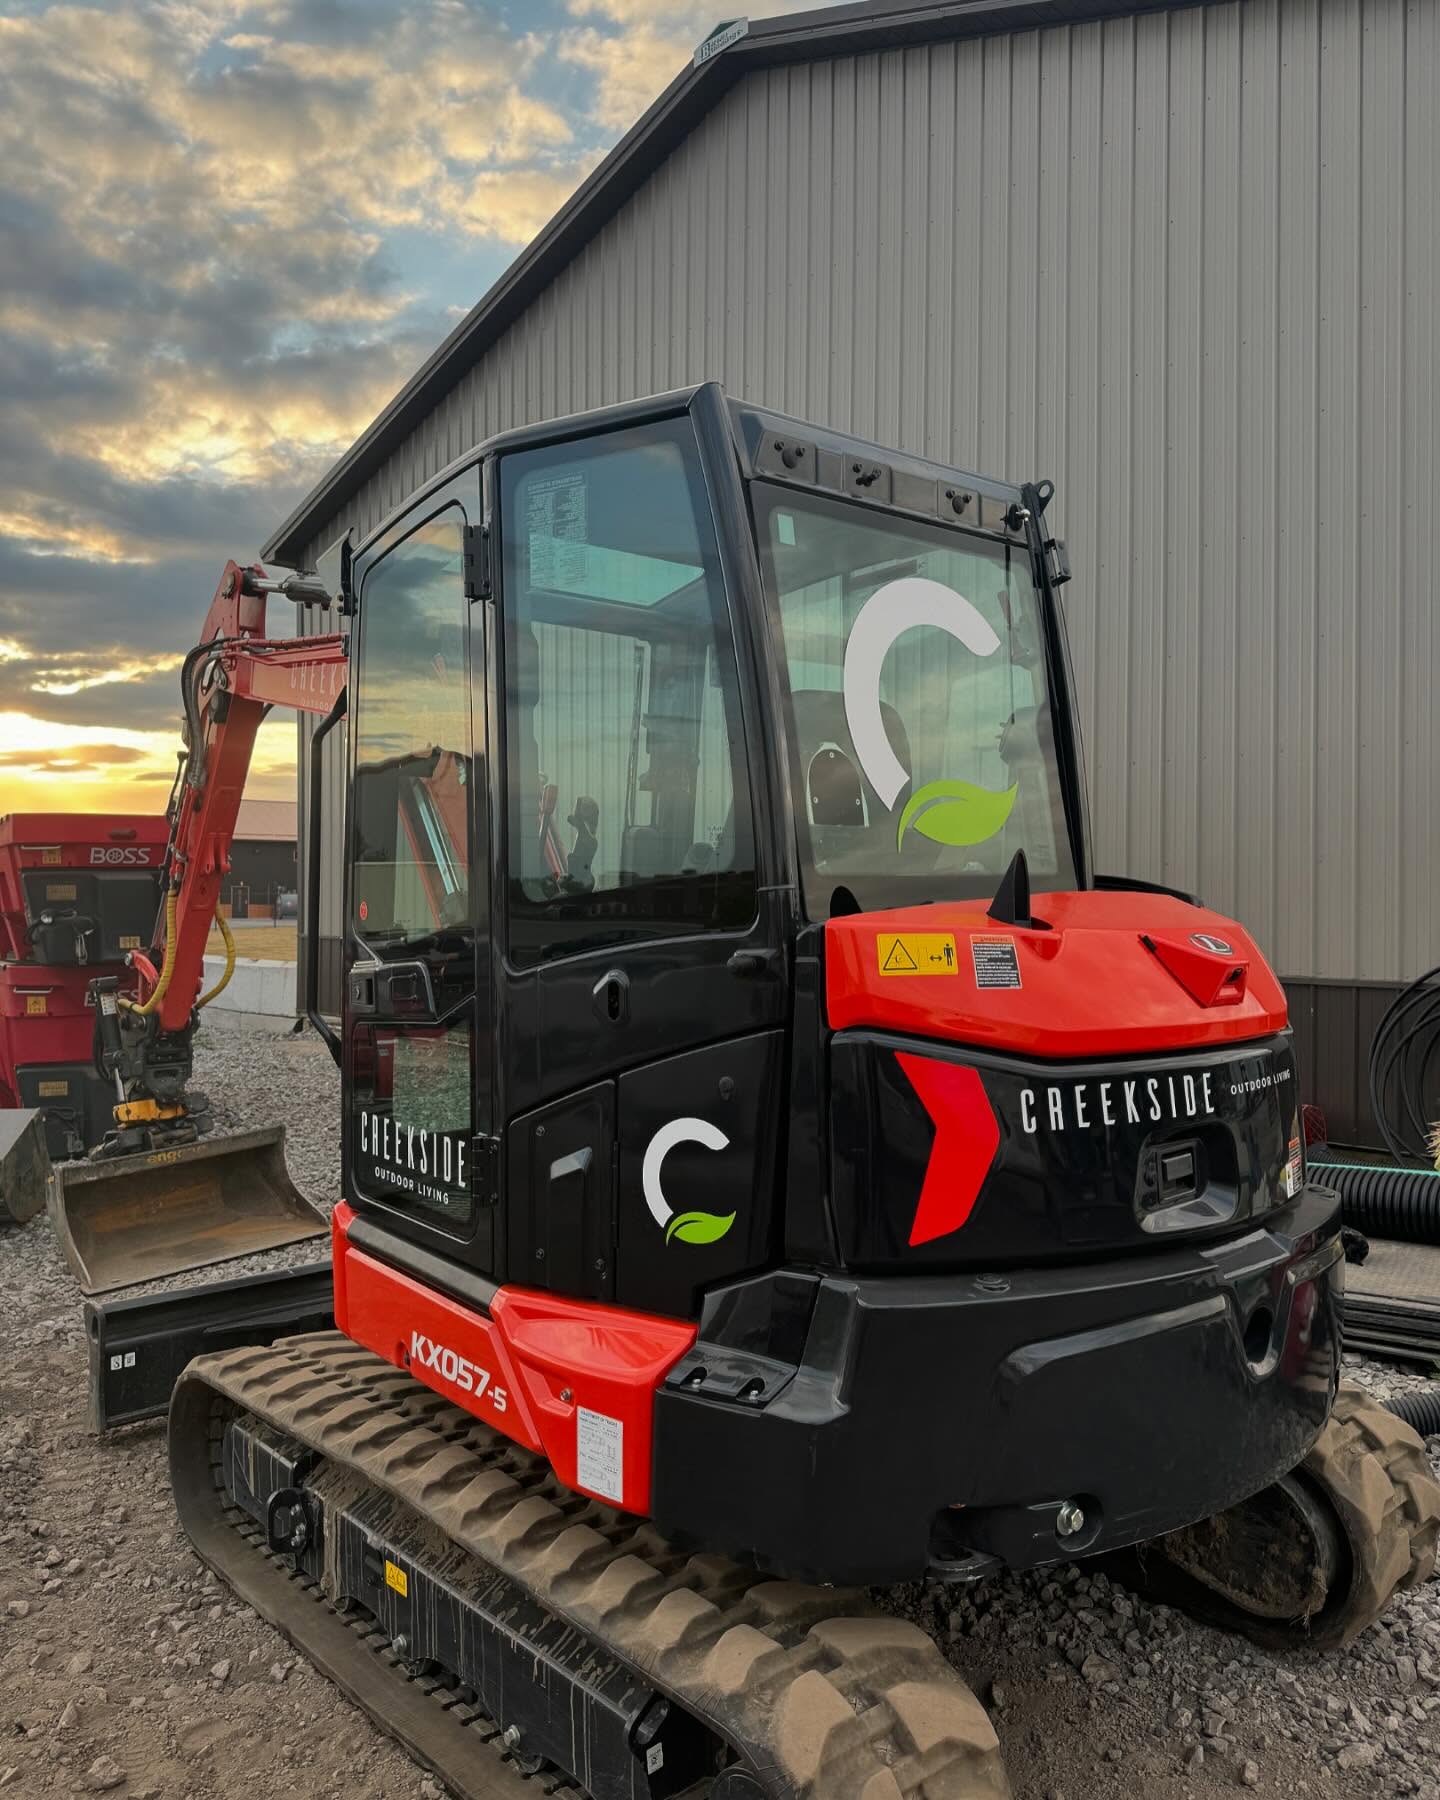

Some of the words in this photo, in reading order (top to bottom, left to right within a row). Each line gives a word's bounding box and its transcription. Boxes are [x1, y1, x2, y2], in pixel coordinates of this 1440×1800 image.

[90, 848, 150, 864] BOSS
[1020, 1073, 1215, 1133] CREEKSIDE
[1230, 1077, 1272, 1096] OUTDOOR
[1273, 1069, 1291, 1084] LIVING
[361, 1111, 467, 1188] CREEKSIDE
[374, 1166, 414, 1192] OUTDOOR
[417, 1183, 449, 1205] LIVING
